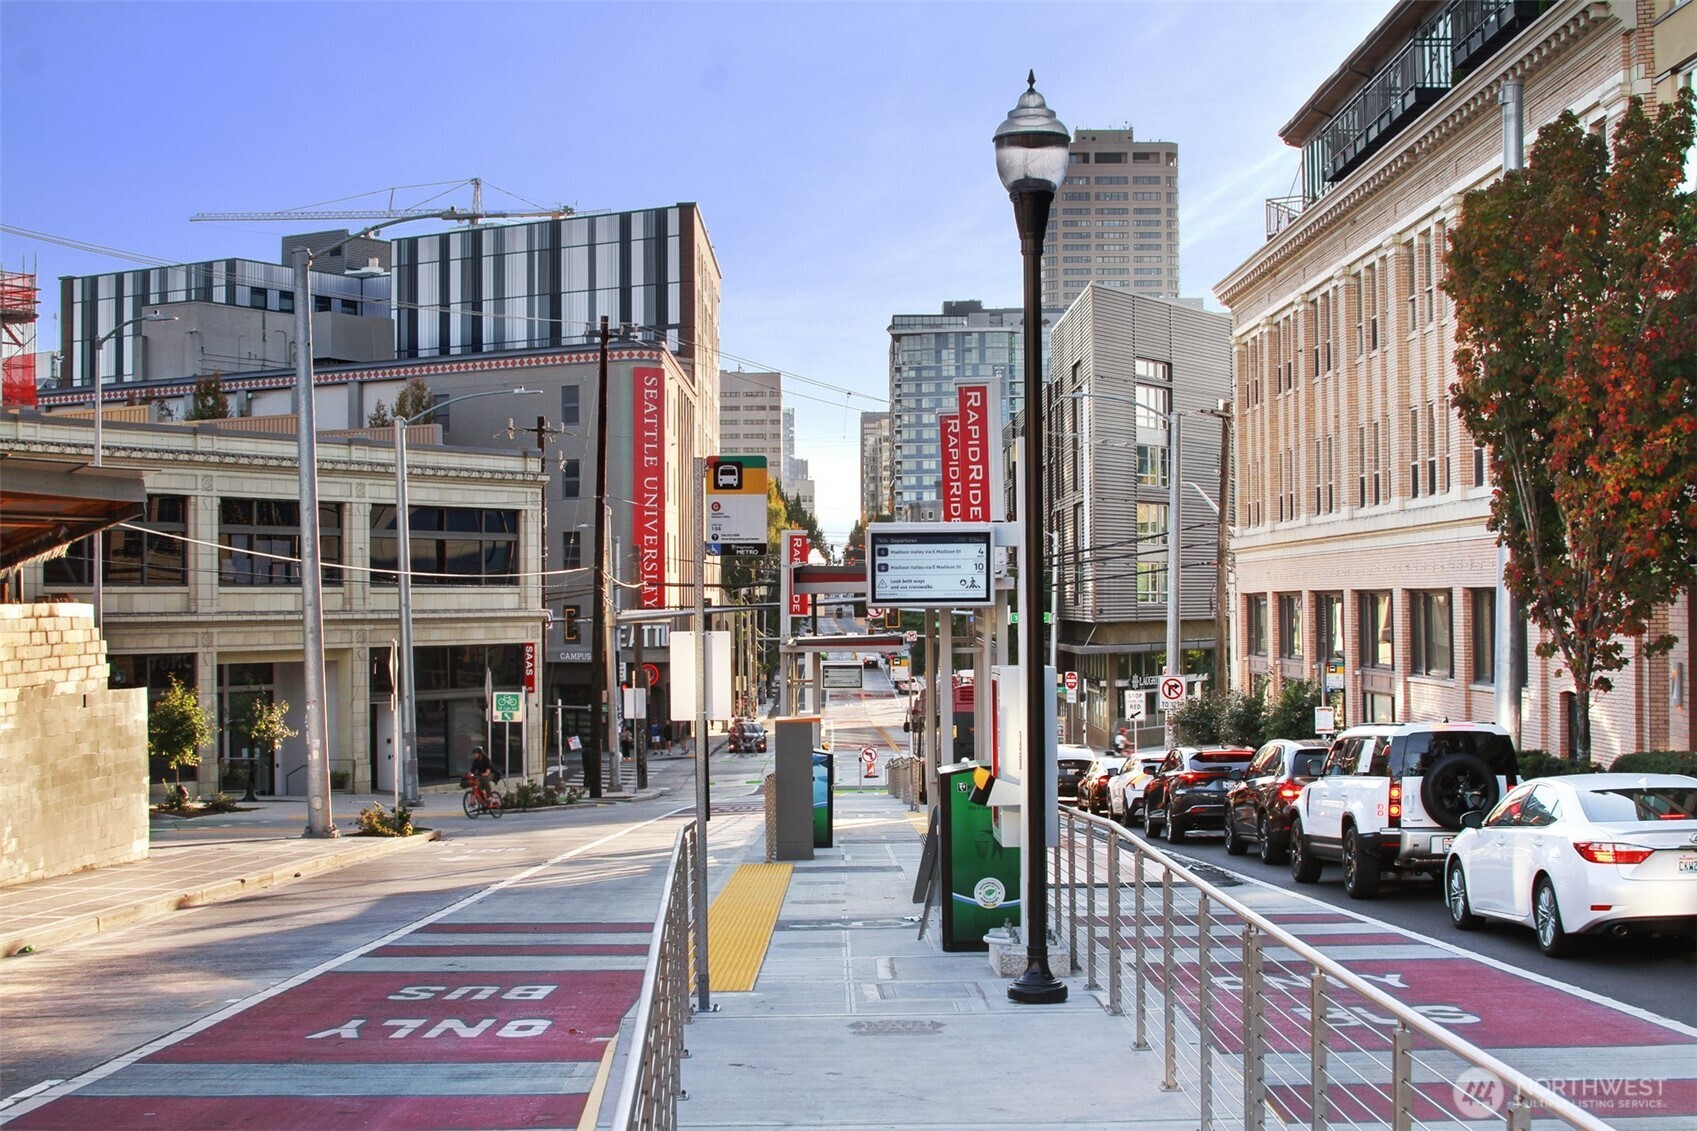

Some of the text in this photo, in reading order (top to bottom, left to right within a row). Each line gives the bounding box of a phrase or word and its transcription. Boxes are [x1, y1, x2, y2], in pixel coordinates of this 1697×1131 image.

[966, 391, 983, 519] RAPIDRIDE
[947, 419, 961, 523] RAPIDRID
[643, 376, 658, 608] SEATTLE UNIVERSITY
[978, 547, 985, 555] 4
[974, 563, 984, 571] 10
[525, 646, 533, 676] SAAS
[560, 652, 592, 660] CAMPUS
[387, 986, 559, 1000] BUS
[1290, 1004, 1481, 1027] BUS
[305, 1019, 553, 1039] ONLY
